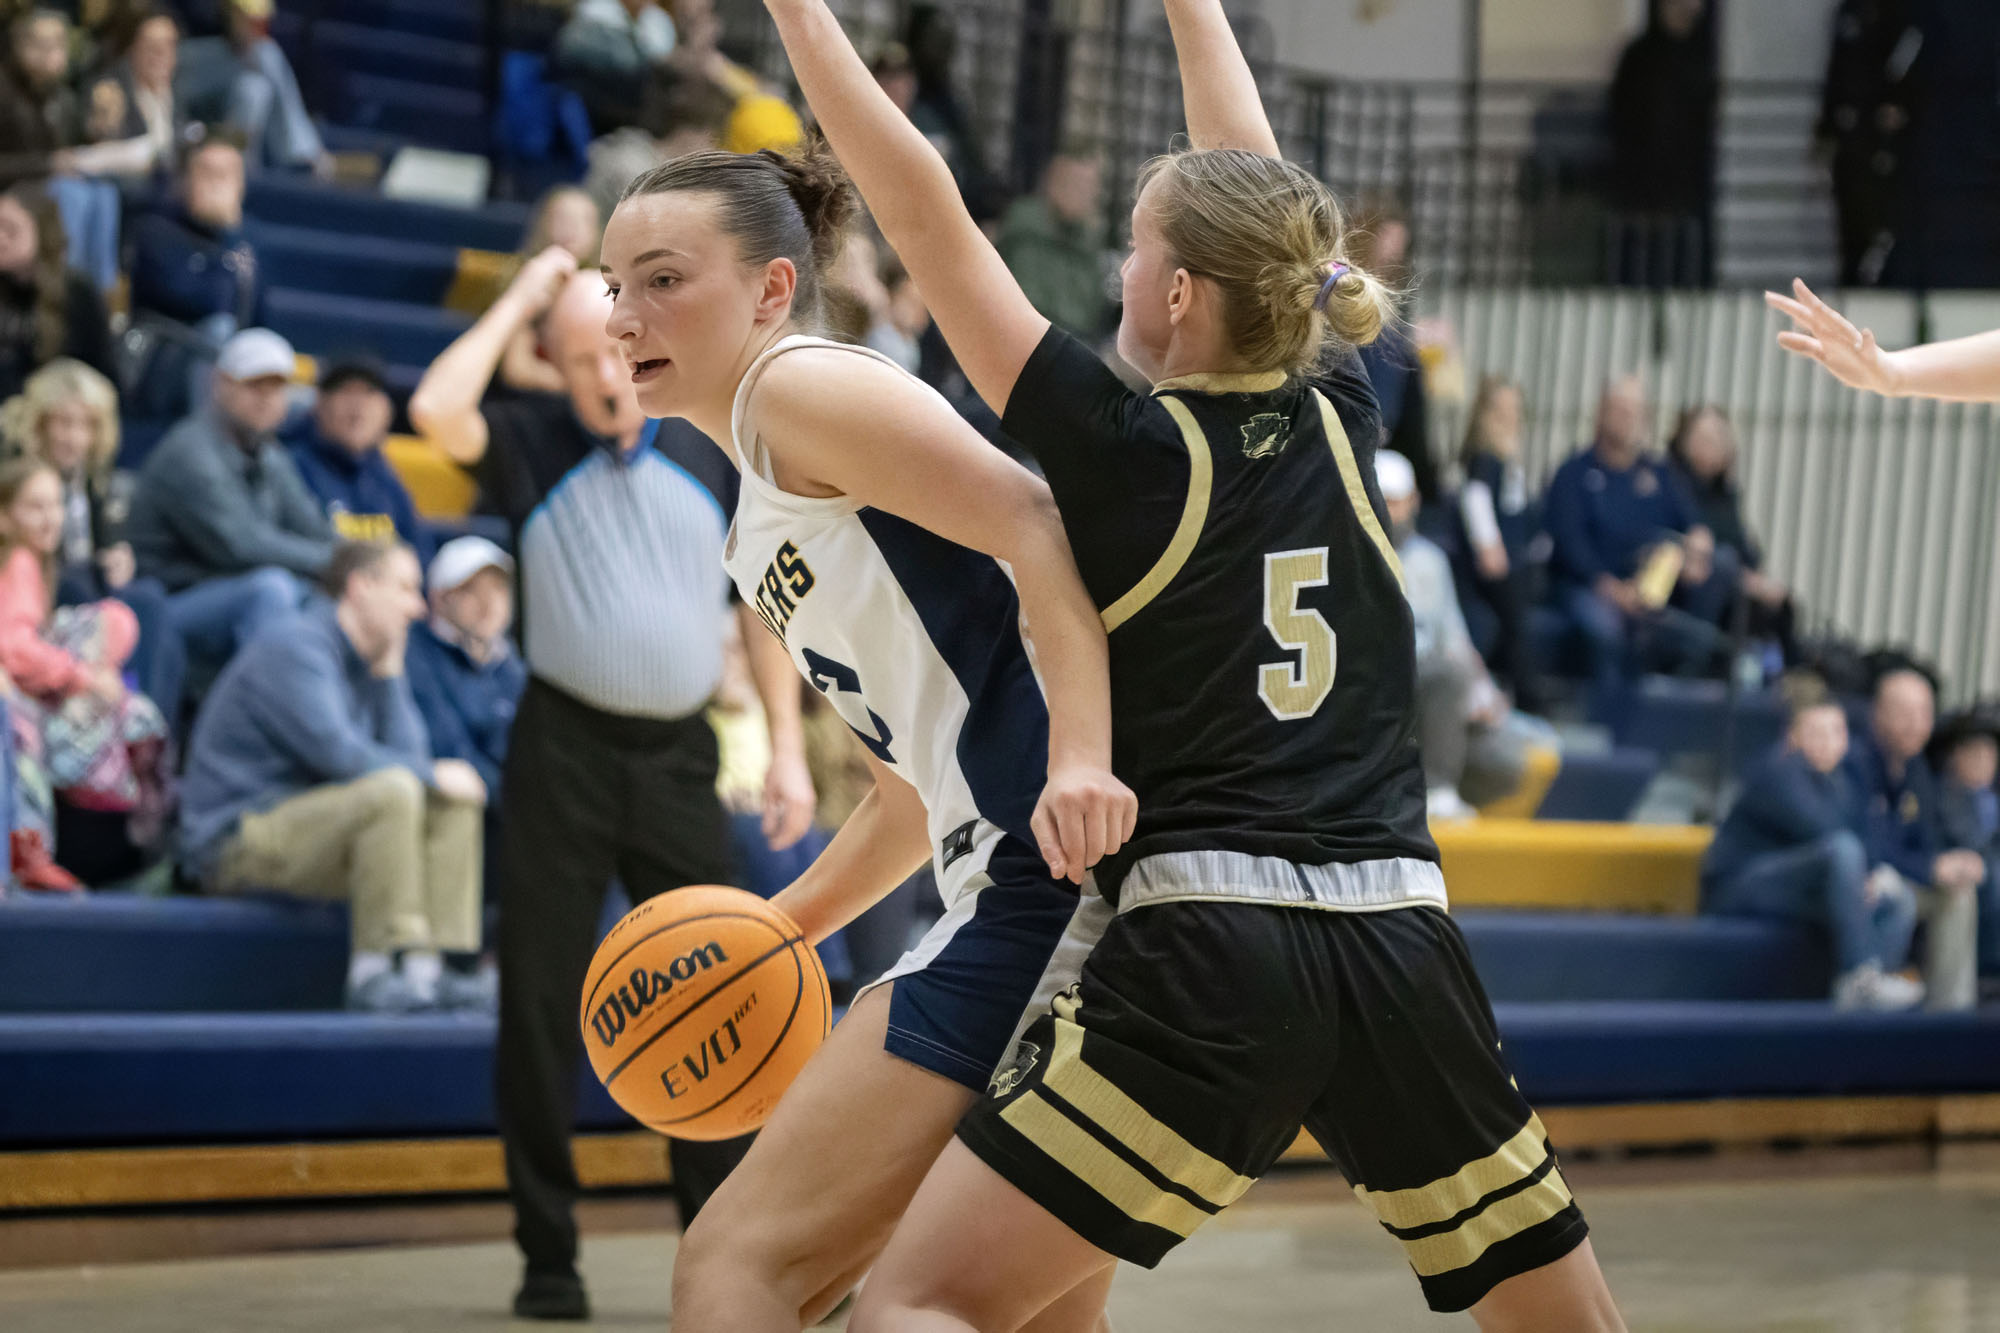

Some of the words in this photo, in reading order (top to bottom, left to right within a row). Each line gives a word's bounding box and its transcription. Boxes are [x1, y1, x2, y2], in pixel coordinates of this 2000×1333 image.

[756, 538, 815, 655] ERS
[1258, 547, 1337, 721] 5
[591, 941, 729, 1048] Wilson
[659, 1017, 742, 1100] EVO
